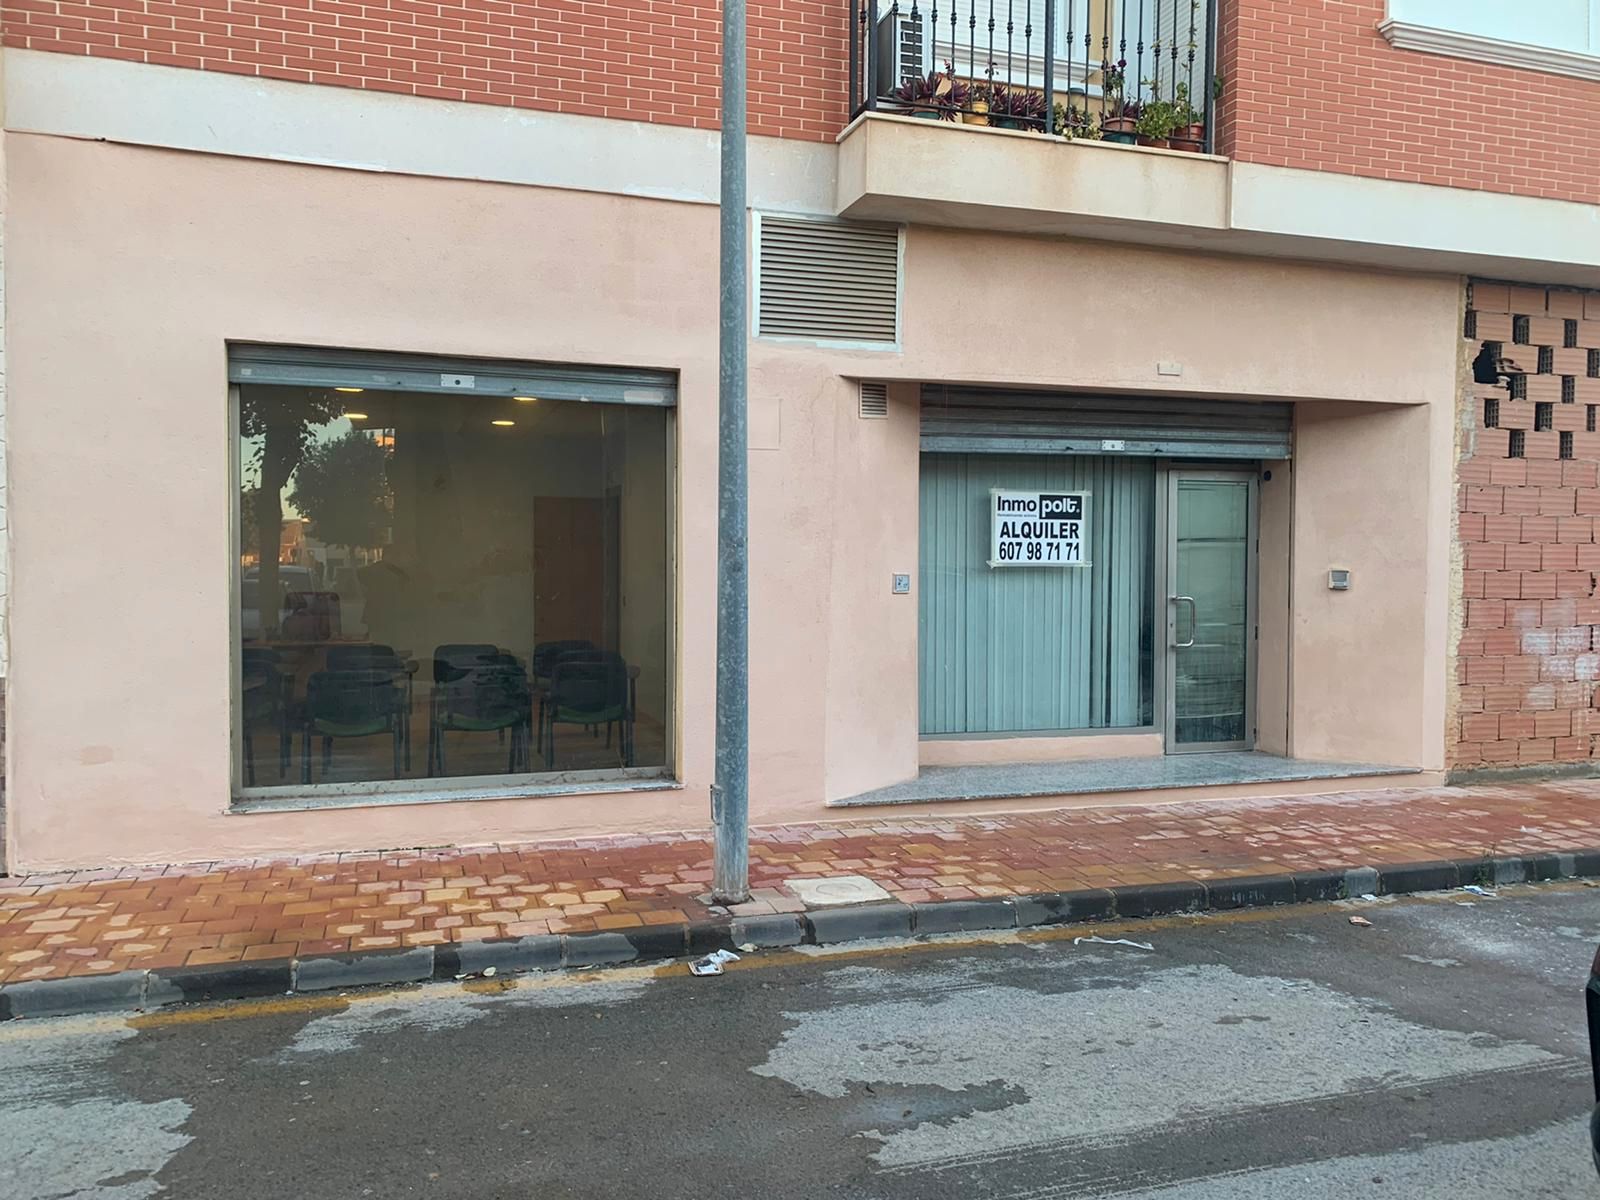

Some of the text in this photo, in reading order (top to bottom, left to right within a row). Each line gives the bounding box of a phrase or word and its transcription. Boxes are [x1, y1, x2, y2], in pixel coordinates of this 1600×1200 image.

[1000, 521, 1080, 539] ALQUILER
[999, 542, 1080, 560] 607 98 71 71
